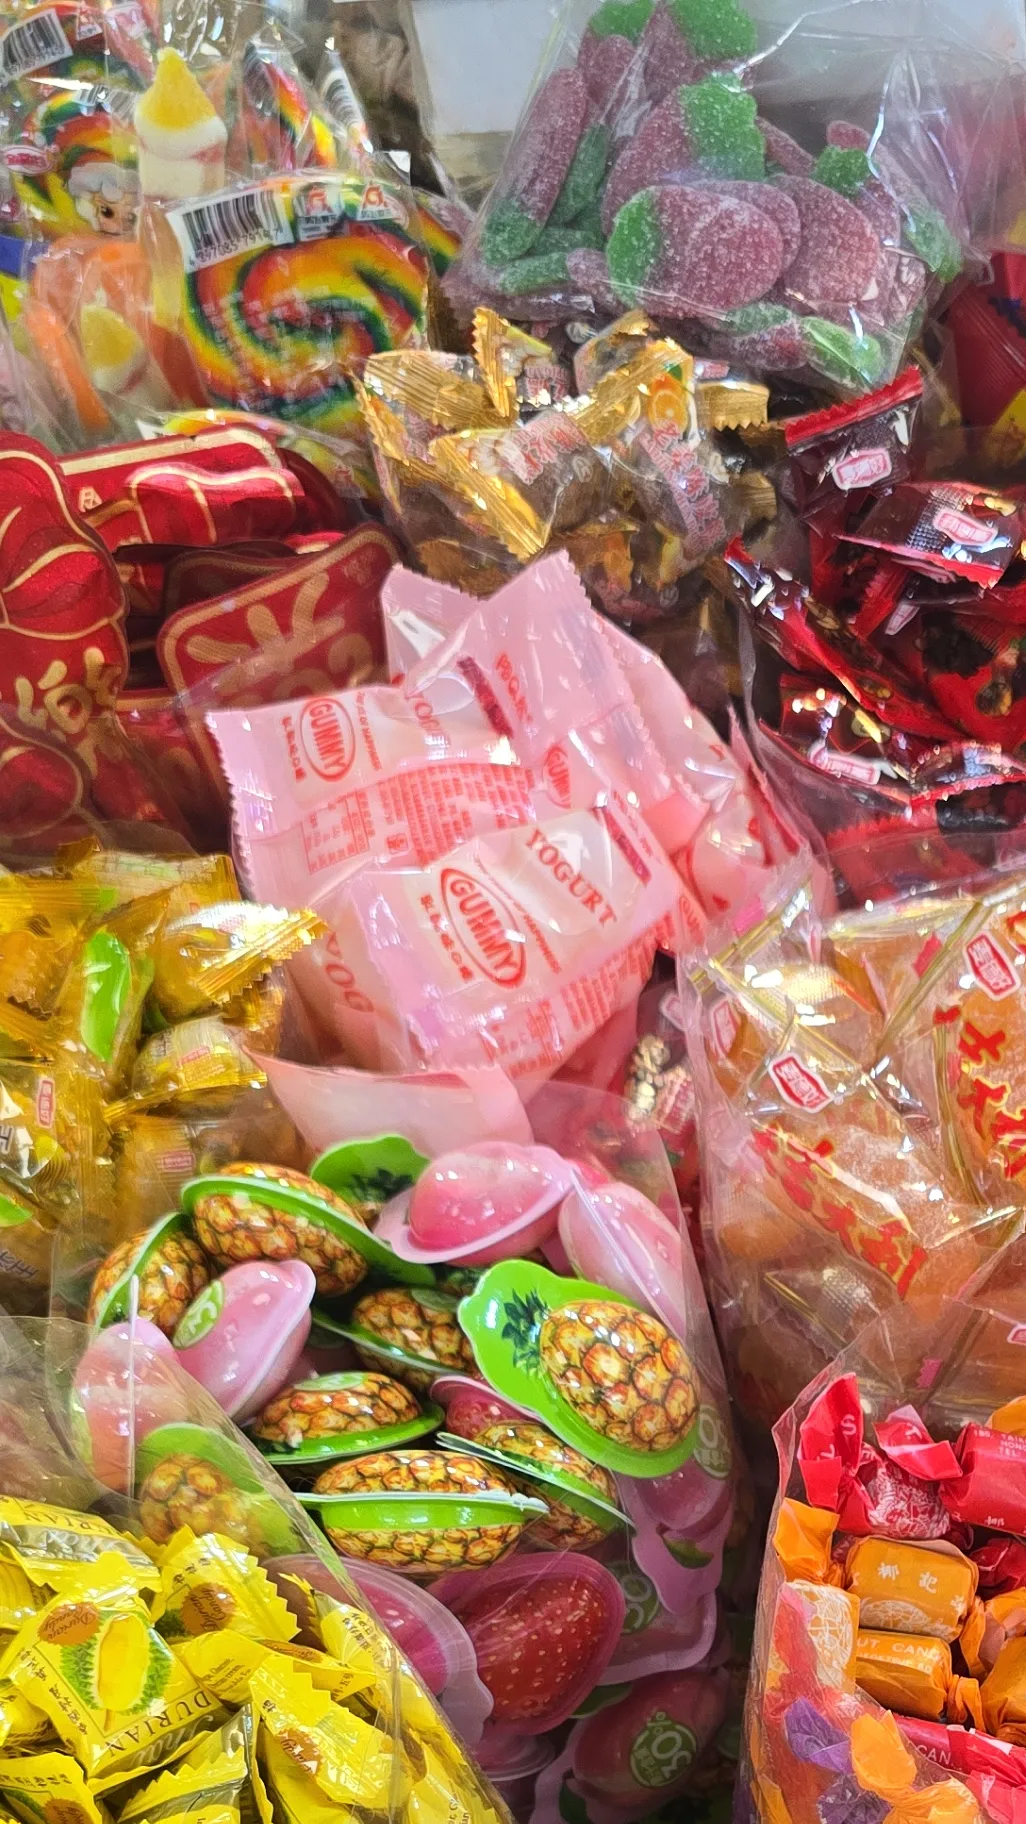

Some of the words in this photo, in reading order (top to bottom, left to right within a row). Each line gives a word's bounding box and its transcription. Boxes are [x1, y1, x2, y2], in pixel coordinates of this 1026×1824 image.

[308, 702, 348, 772] GUMMY
[525, 828, 617, 927] YOGURT
[449, 878, 518, 978] GUMMY
[106, 1690, 215, 1758] DURIAN
